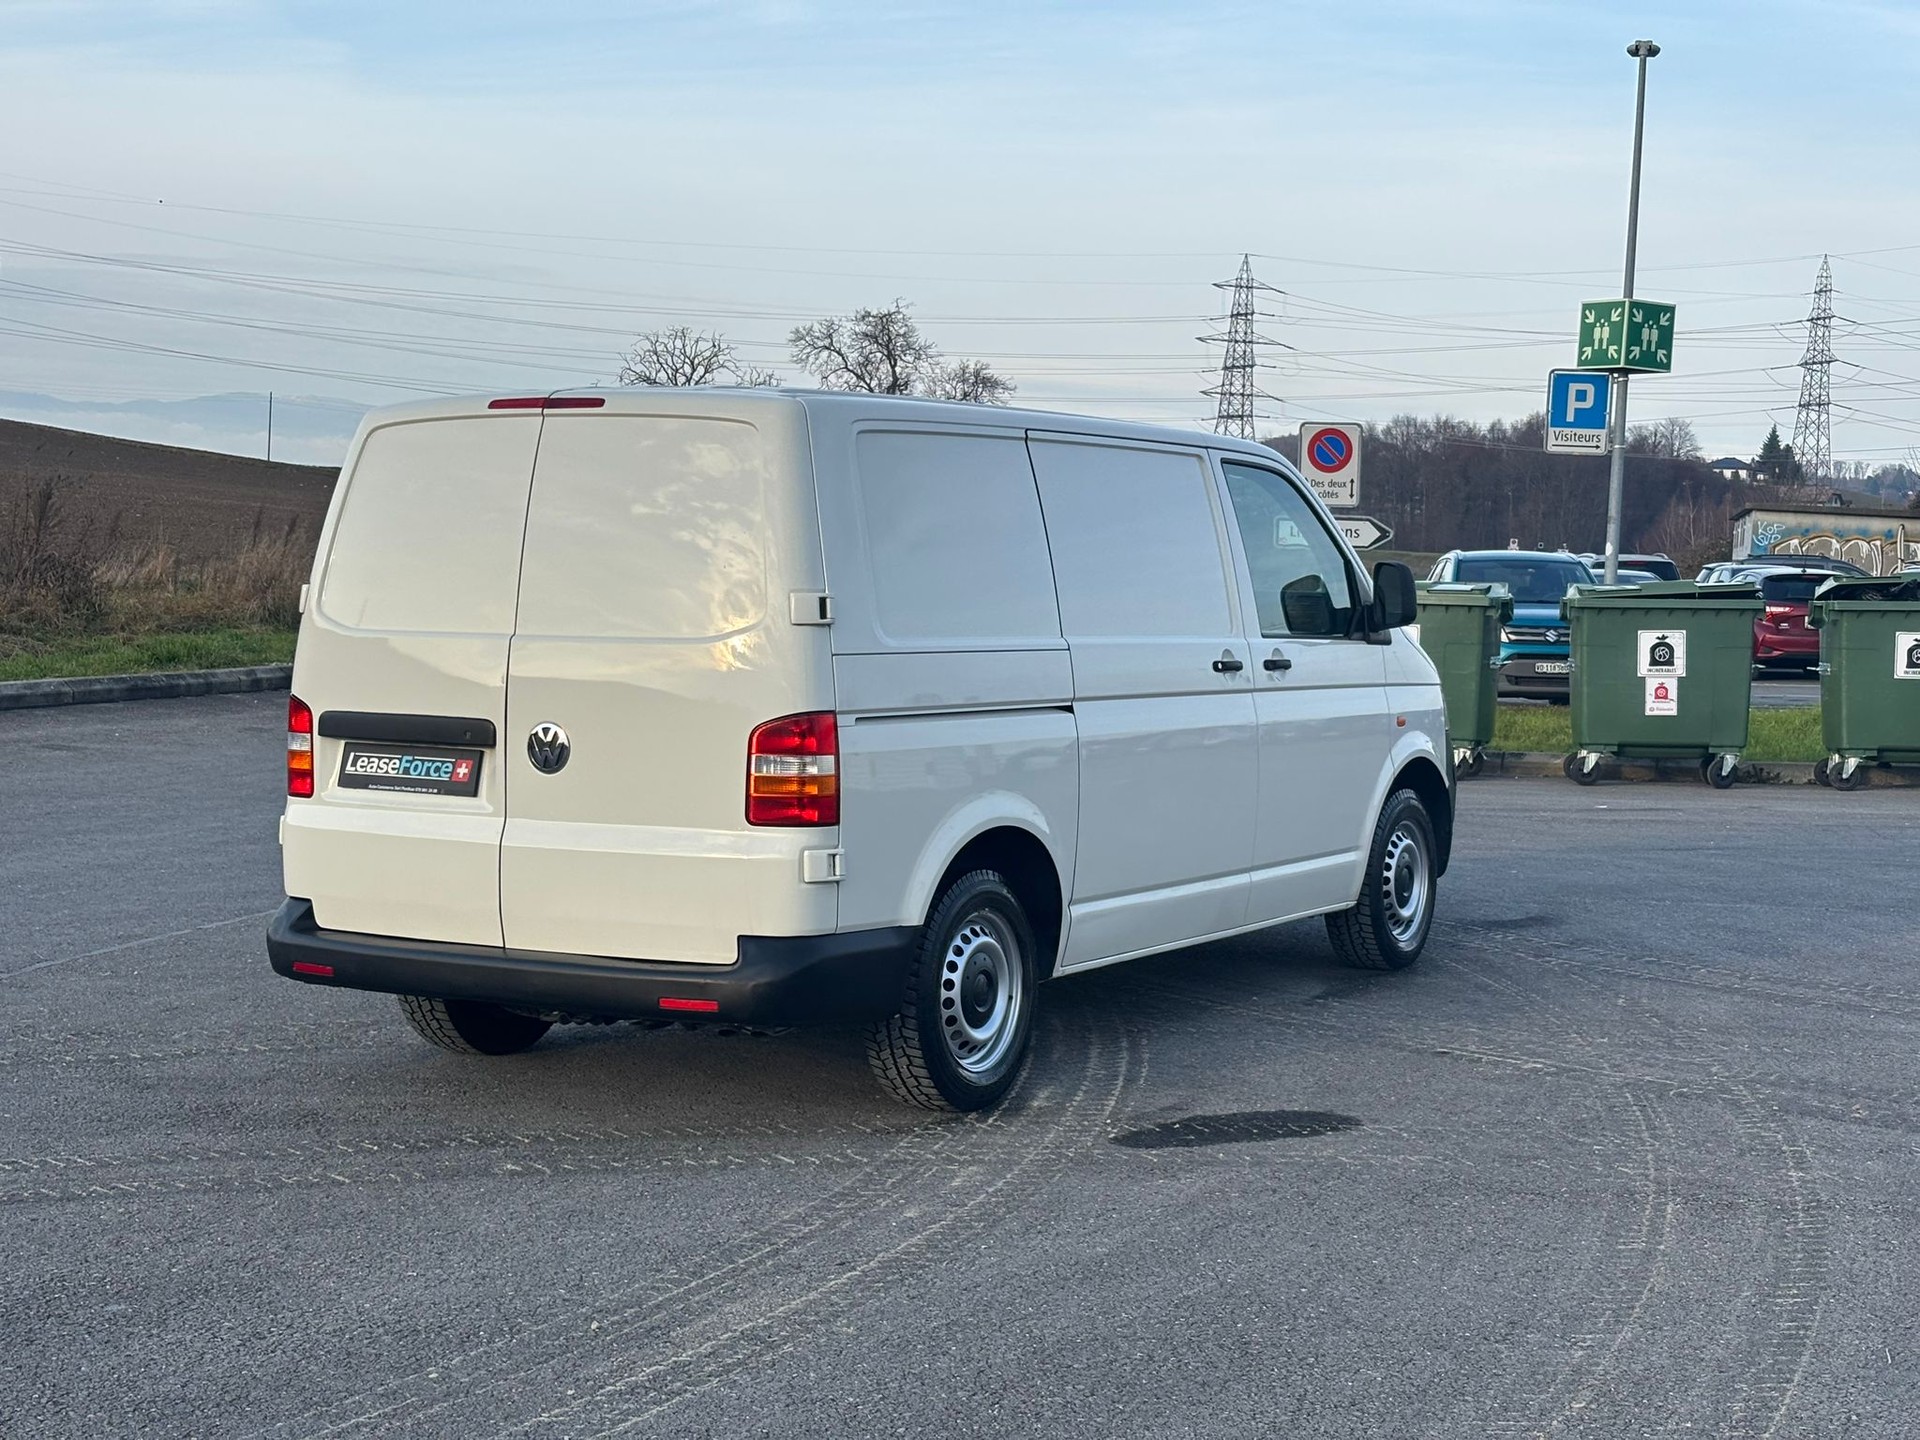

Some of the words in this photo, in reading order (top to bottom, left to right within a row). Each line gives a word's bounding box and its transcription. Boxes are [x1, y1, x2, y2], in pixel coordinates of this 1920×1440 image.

[1566, 383, 1595, 422] P
[1553, 430, 1601, 443] Visiteurs
[1311, 479, 1325, 488] Des
[1328, 479, 1347, 488] deux
[1318, 489, 1339, 499] côtés
[345, 752, 453, 777] LeaseForce
